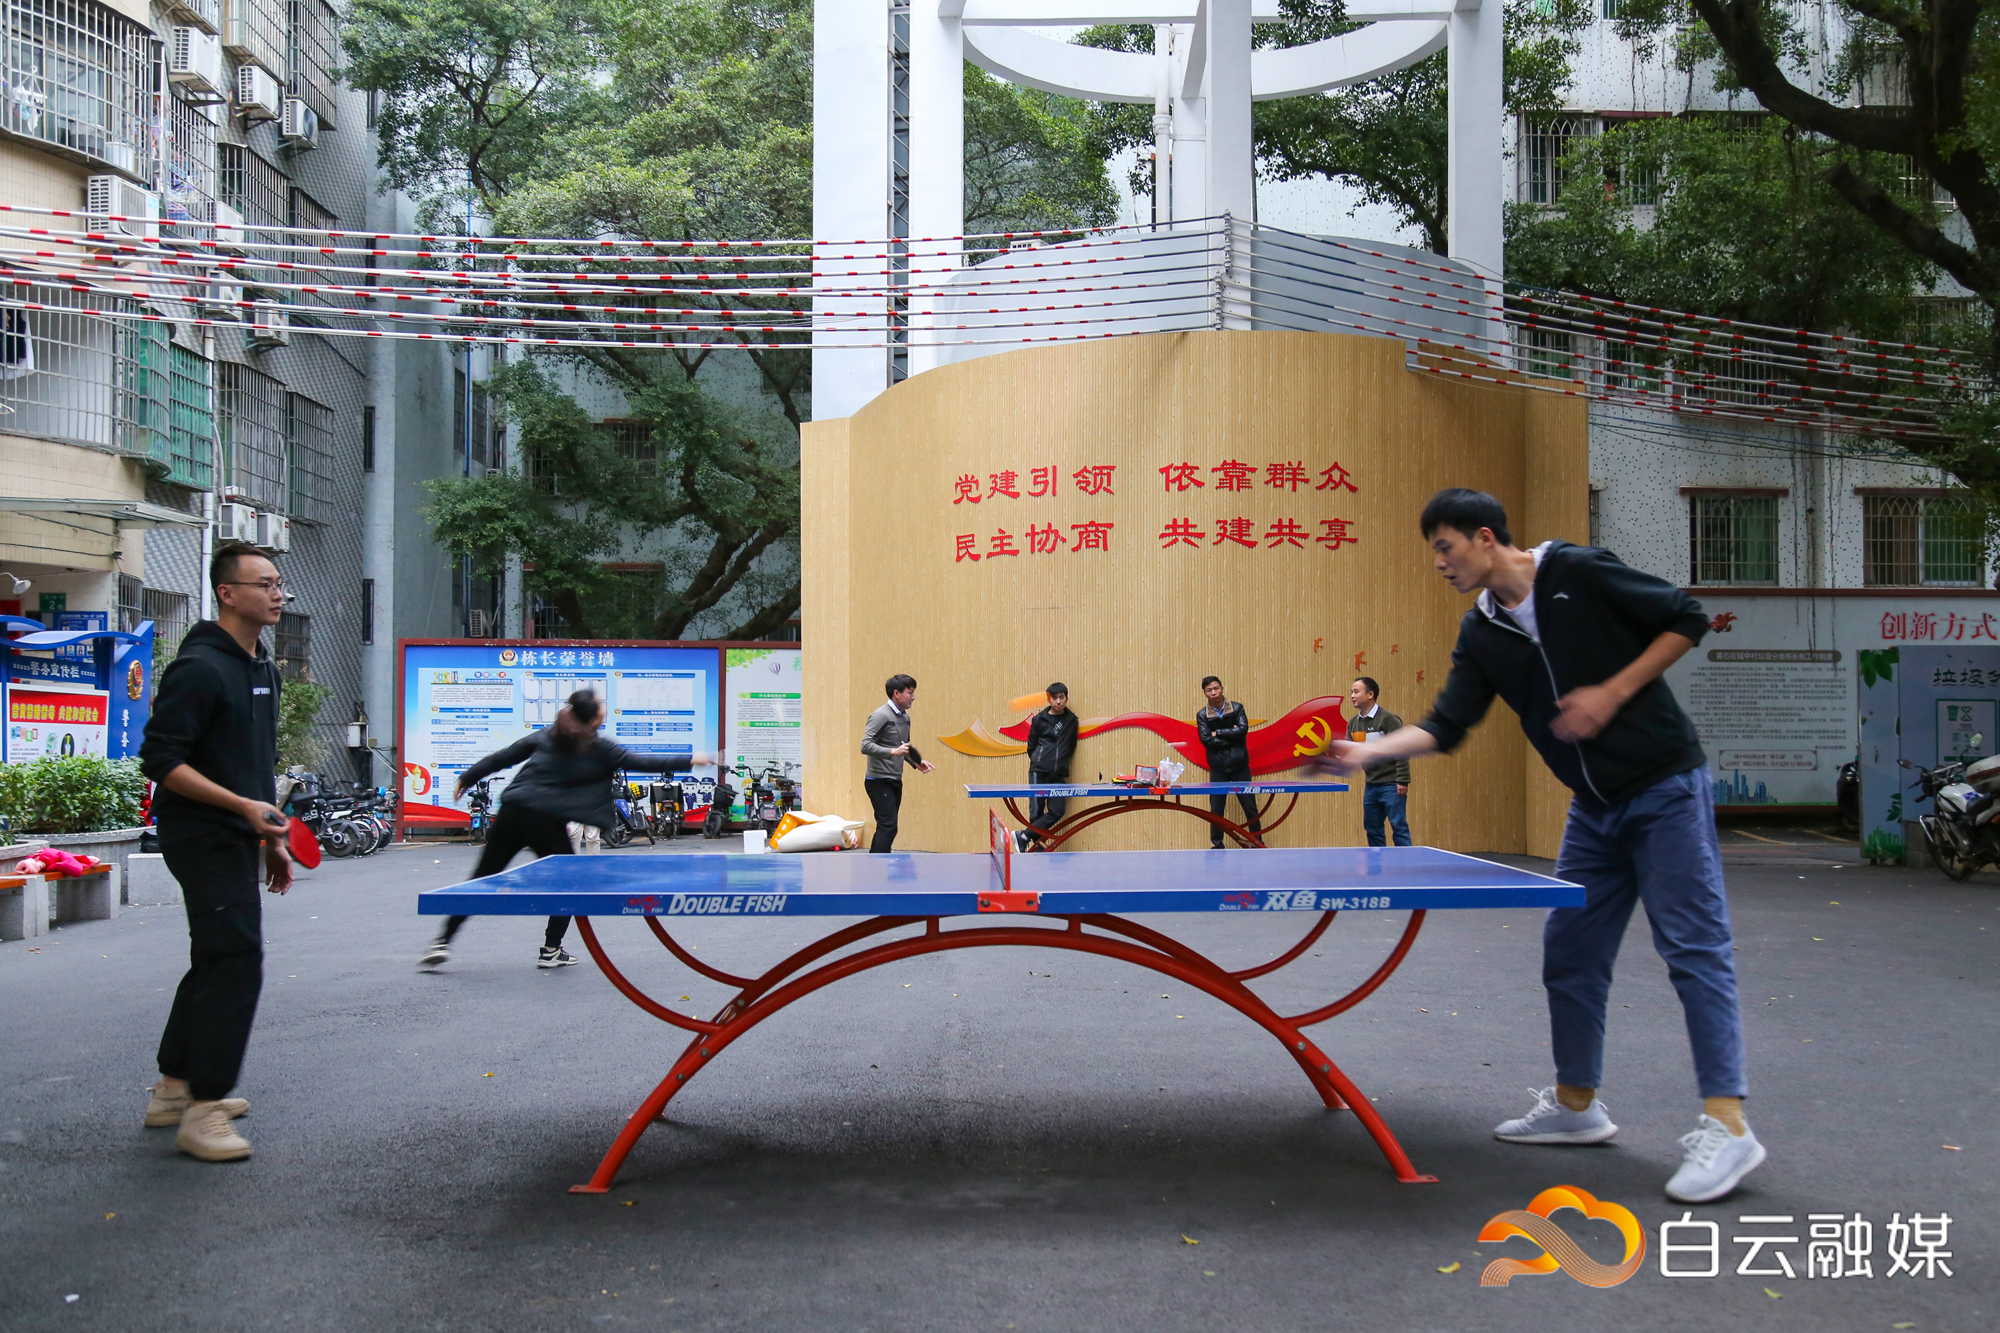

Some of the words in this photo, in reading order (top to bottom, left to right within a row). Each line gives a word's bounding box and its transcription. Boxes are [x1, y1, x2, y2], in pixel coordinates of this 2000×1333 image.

[953, 464, 1117, 505] 党建引领
[1159, 459, 1359, 493] 依靠群众
[955, 519, 1115, 562] 民主协商
[1159, 516, 1359, 550] 共建共享
[1880, 611, 1999, 641] 创新方式
[521, 650, 615, 667] 栋长荣誉墙
[30, 661, 80, 678] 警务宣传栏
[12, 703, 55, 721] 禁黄禁赌禁毒
[58, 705, 99, 722] 共建和谐社会
[1050, 789, 1074, 797] DOUBLE
[667, 894, 742, 914] DOUBLE
[743, 895, 788, 913] FISH
[1262, 891, 1318, 911] 双鱼
[1320, 896, 1391, 910] SW-318B
